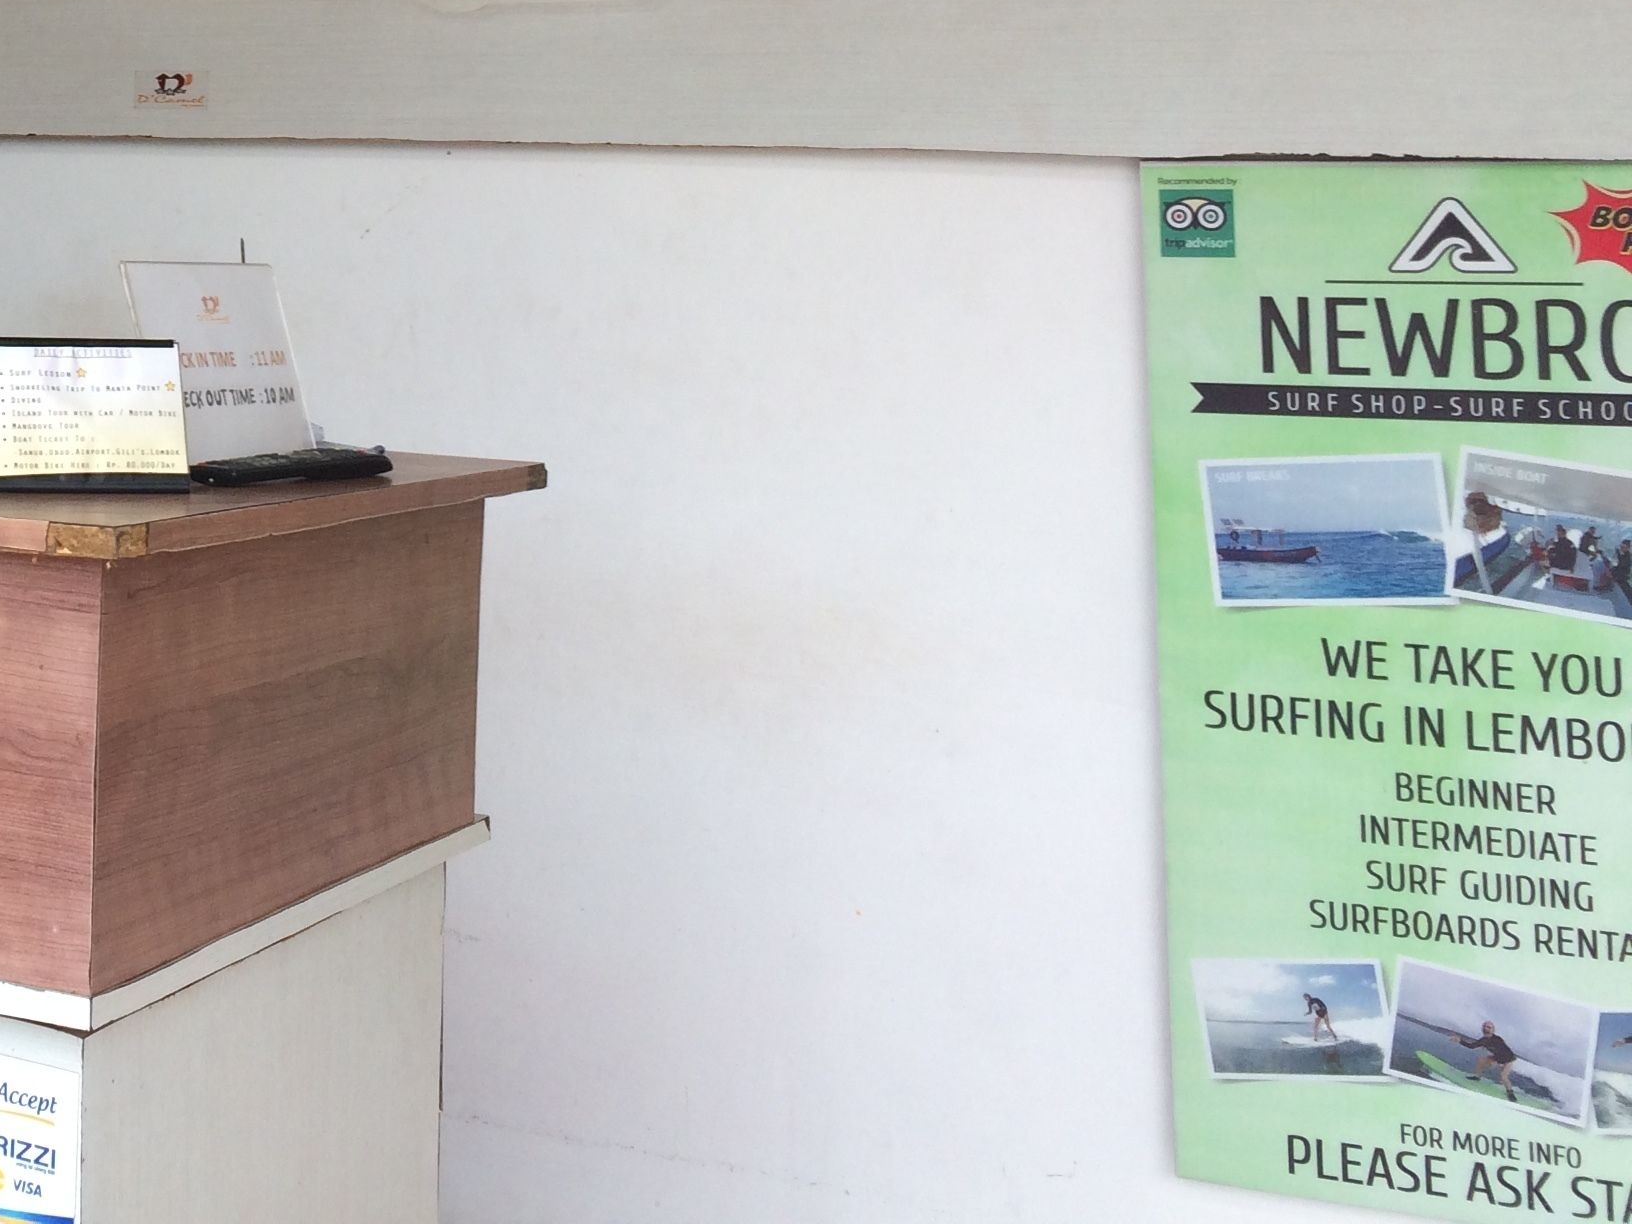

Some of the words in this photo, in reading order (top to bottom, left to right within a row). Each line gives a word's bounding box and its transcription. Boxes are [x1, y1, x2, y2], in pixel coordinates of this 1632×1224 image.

[1157, 177, 1221, 185] Recommended
[1226, 177, 1237, 186] by
[1165, 237, 1233, 249] tripadvisor
[195, 352, 209, 368] IN
[209, 351, 237, 367] TIME
[270, 350, 287, 366] AM
[1259, 295, 1632, 384] NEWBRO
[183, 390, 204, 408] ECK
[206, 389, 228, 406] OUT
[228, 388, 256, 406] TIME
[278, 387, 295, 405] AM
[1266, 390, 1340, 413] SURF
[1214, 471, 1242, 483] SURF
[1473, 461, 1511, 478] INSIDE
[1517, 468, 1549, 484] BOAT
[1321, 637, 1389, 680] WE
[1403, 642, 1515, 691] TAKE
[1531, 651, 1622, 697] YOU
[1204, 689, 1385, 744] SURFING
[1403, 705, 1446, 749] IN
[1465, 710, 1632, 763] LEMBO
[1394, 771, 1557, 816] BEGINNER
[1359, 813, 1599, 867] INTERMEDIATE
[1366, 859, 1447, 897] SURF
[1460, 869, 1594, 913] GUIDING
[1309, 898, 1521, 952] SURFBOARDS
[1534, 923, 1632, 963] RENTA
[1399, 1122, 1444, 1150] FOR
[1451, 1129, 1521, 1162] MORE
[1529, 1141, 1582, 1170] INFO
[13, 1178, 42, 1197] VISA
[1286, 1133, 1448, 1199] PLEASE
[1465, 1161, 1555, 1214] ASK
